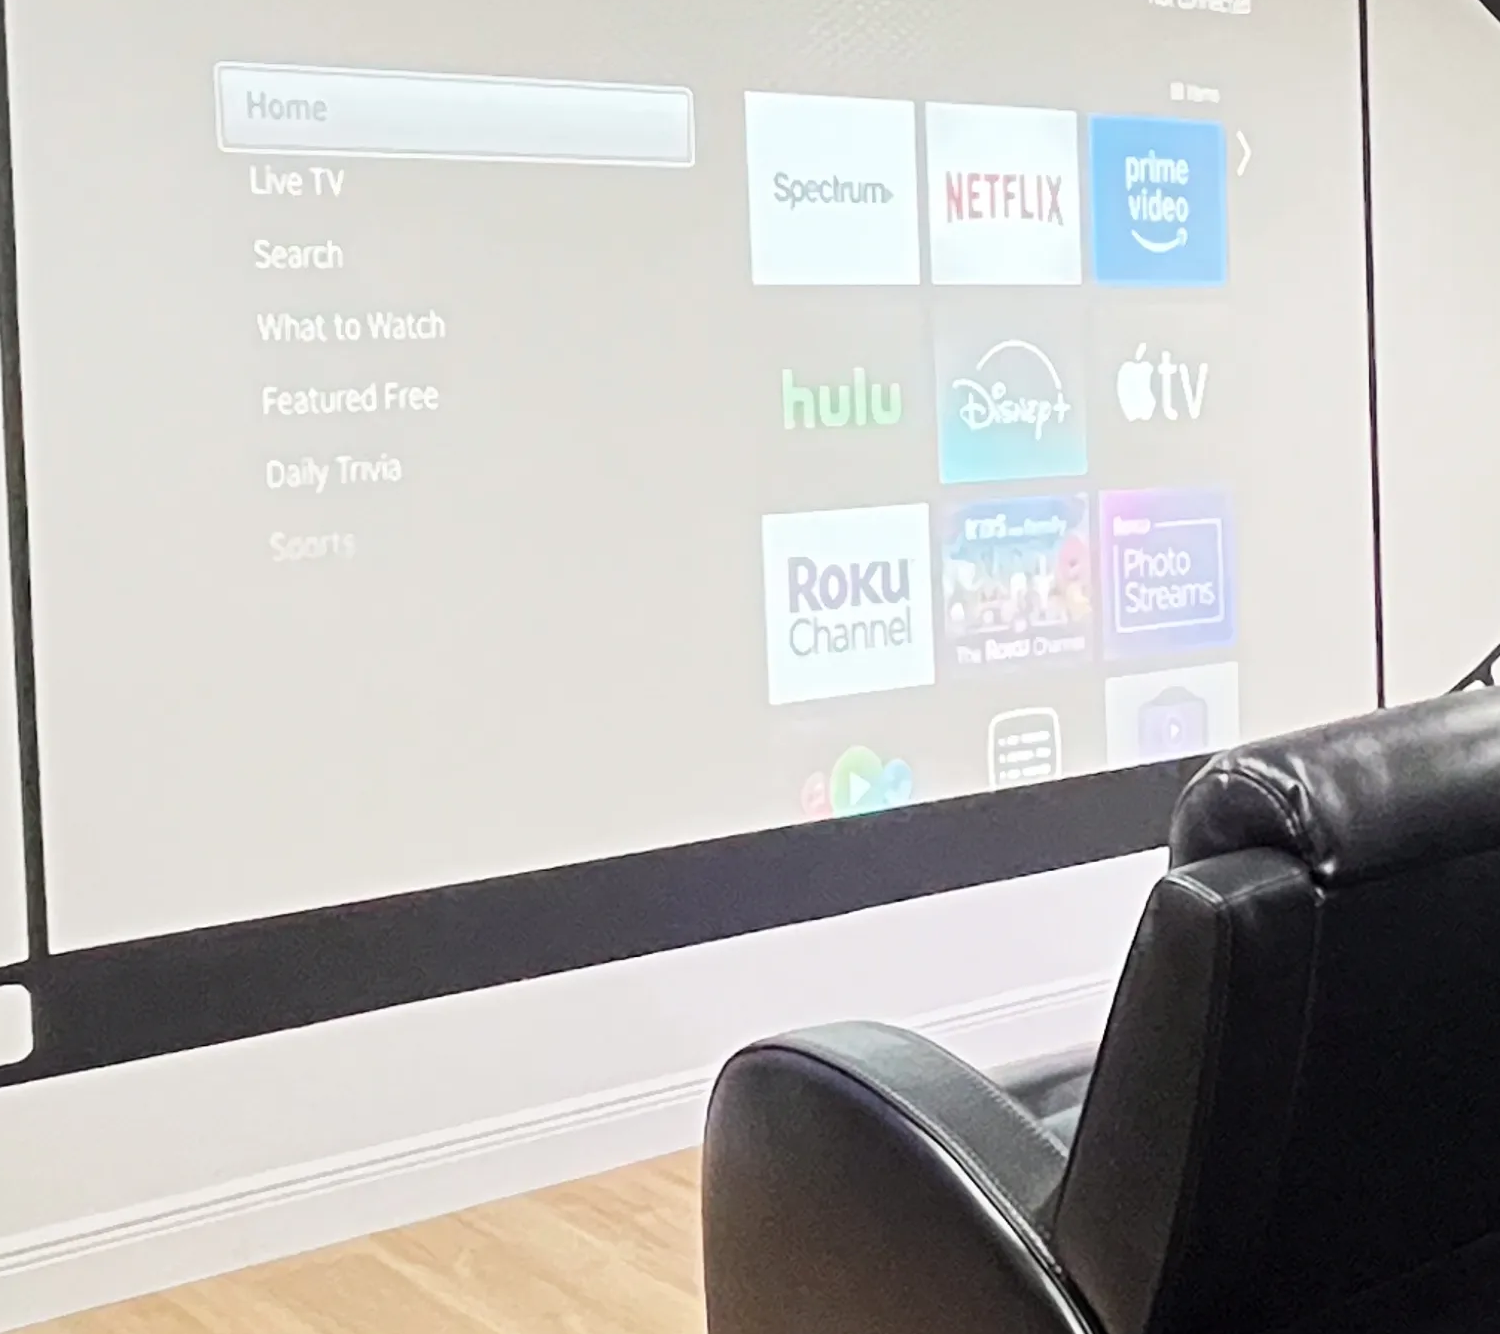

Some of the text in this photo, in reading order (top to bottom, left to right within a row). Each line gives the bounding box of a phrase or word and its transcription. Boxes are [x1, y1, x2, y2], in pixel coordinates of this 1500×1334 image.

[246, 91, 327, 122] Home
[249, 167, 344, 198] Live TV
[1125, 149, 1189, 190] prime
[773, 171, 888, 210] Spectrum
[945, 171, 1065, 225] NETFLIX
[1128, 191, 1189, 224] video
[253, 239, 343, 269] Search
[257, 310, 445, 342] What to Watch
[262, 383, 440, 416] Featured Free
[781, 366, 903, 431] hulu
[1157, 351, 1209, 421] tv
[266, 453, 402, 494] Daily Trivia
[1123, 546, 1192, 580] Photo
[787, 556, 911, 614] Roku
[1124, 580, 1216, 614] Streams
[789, 605, 912, 656] Channel
